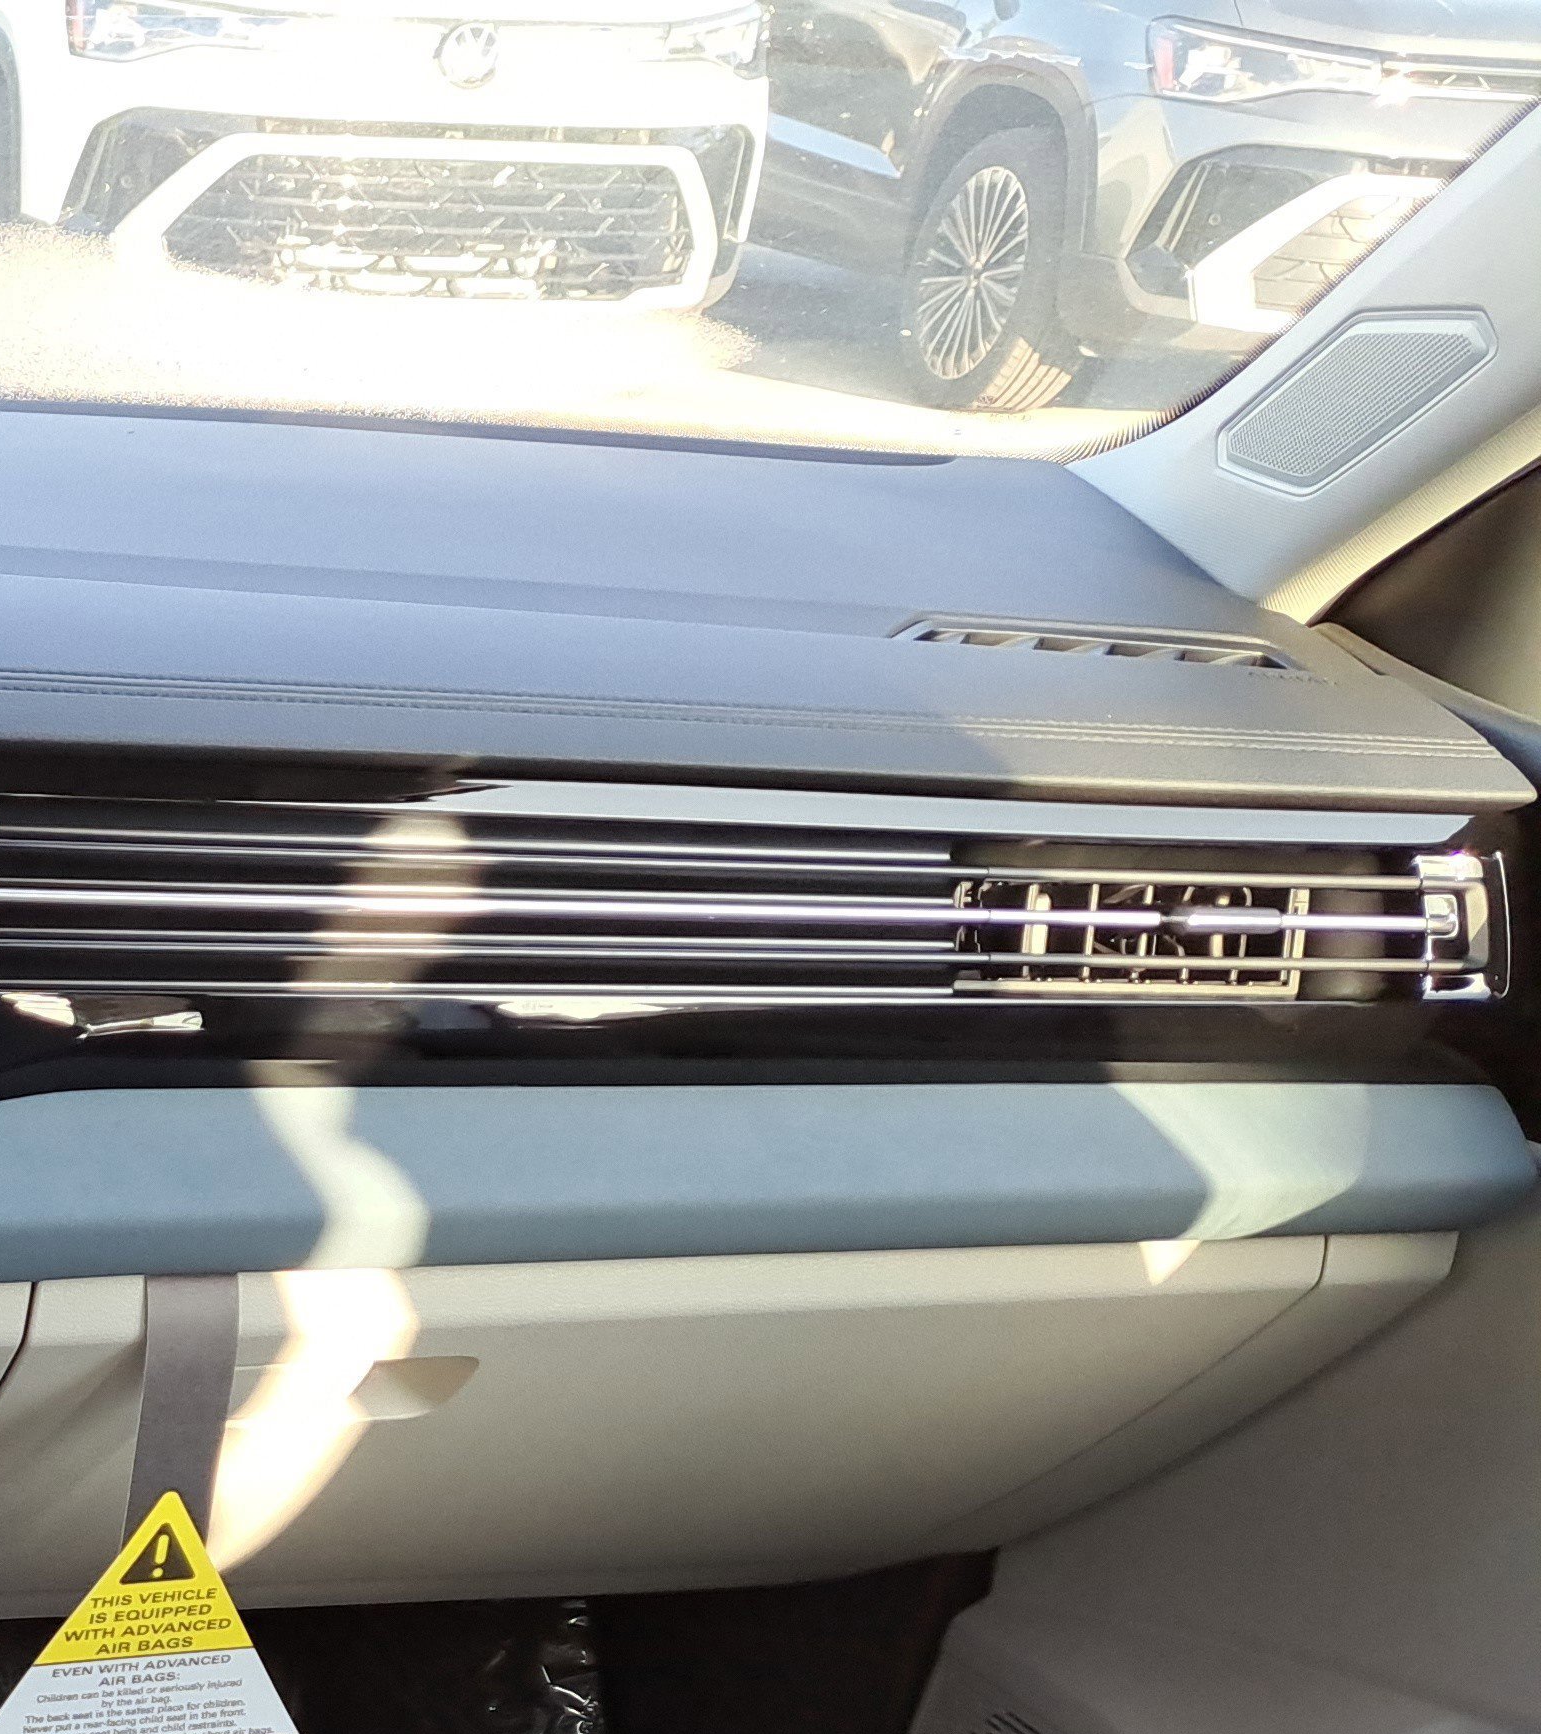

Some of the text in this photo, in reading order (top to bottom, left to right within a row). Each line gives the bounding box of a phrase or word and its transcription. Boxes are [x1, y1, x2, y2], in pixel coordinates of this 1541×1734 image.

[90, 1587, 218, 1609] THIS VEHICLE
[89, 1604, 213, 1625] IS EQUIPPED
[64, 1618, 232, 1642] WITH ADVANCED
[95, 1636, 194, 1656] AIR BAGS
[52, 1654, 232, 1678] EVEN WITH ADVANCED
[98, 1671, 181, 1687] AIR BAGS:
